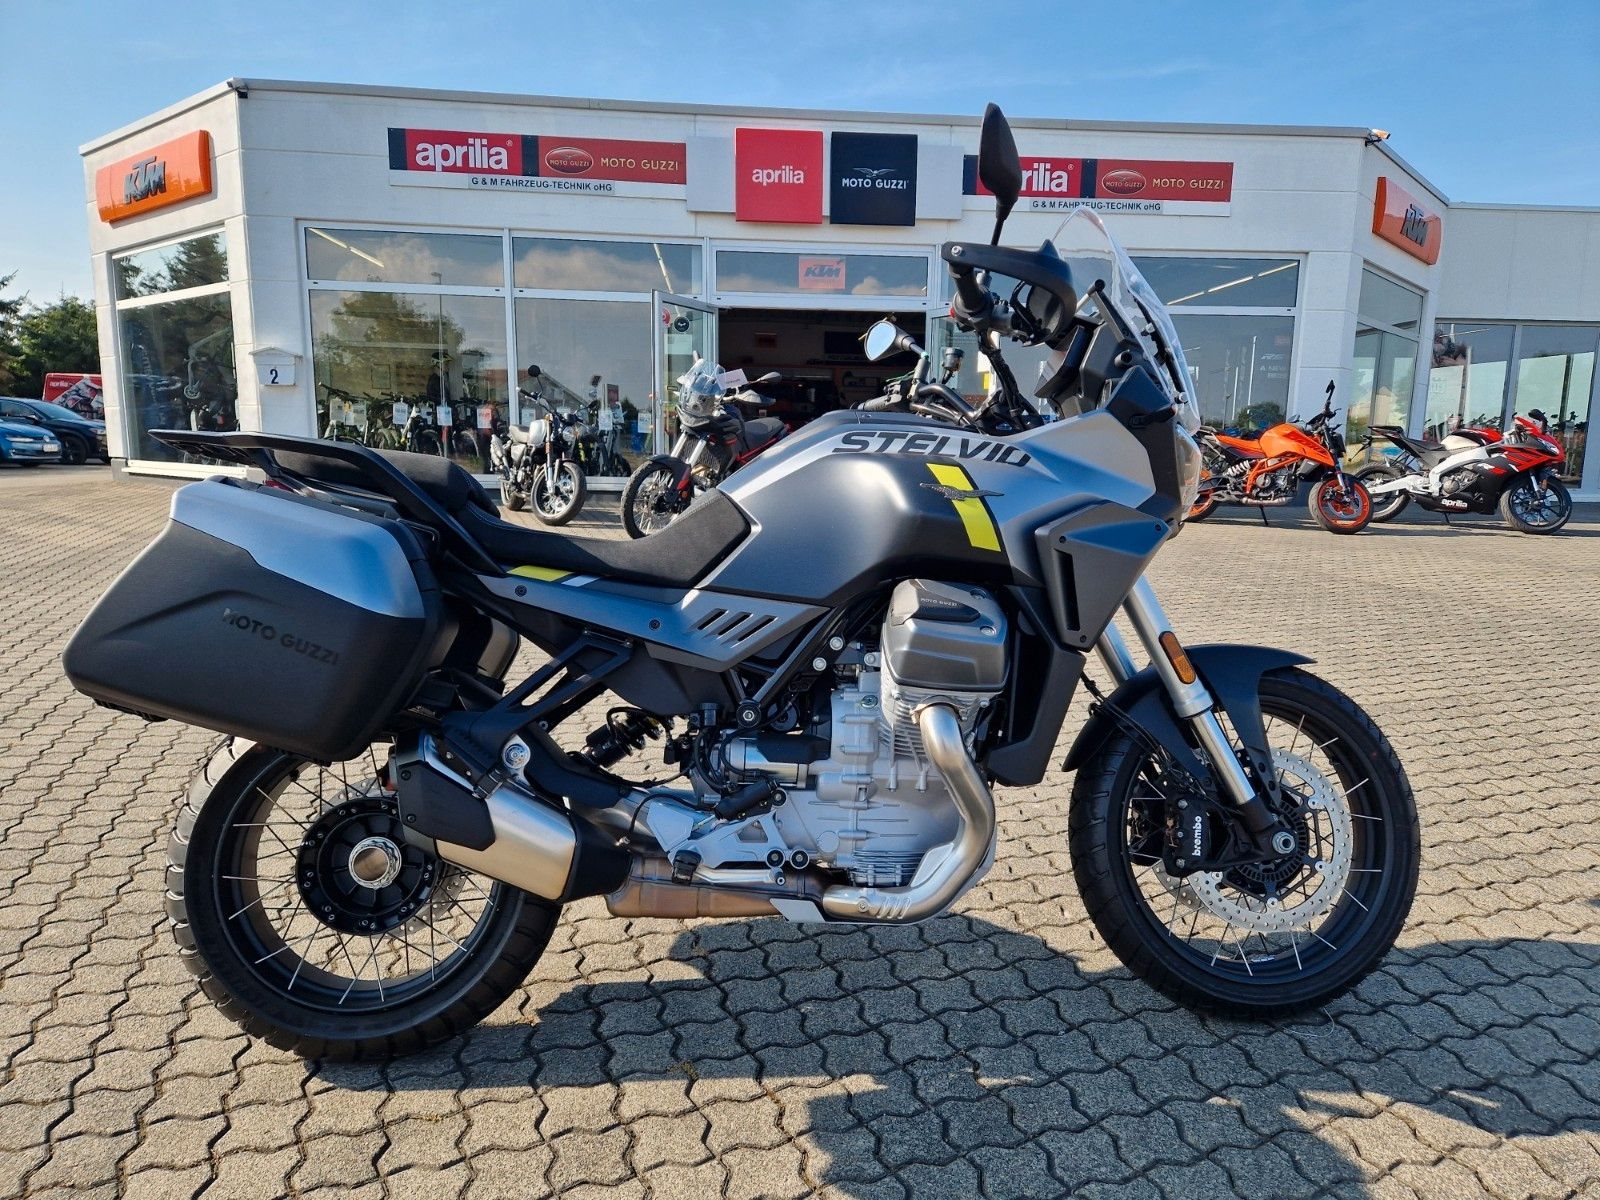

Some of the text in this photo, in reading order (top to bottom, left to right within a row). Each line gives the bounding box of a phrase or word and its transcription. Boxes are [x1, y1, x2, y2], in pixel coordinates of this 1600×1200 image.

[415, 137, 509, 172] aprilia
[600, 157, 679, 172] MOTO GUZZI
[123, 155, 166, 205] KTM
[471, 177, 613, 192] G & M FAHRZEUG-TECHNIK oHG
[751, 165, 805, 187] aprilia
[841, 177, 907, 190] MOTO GUZZI
[1020, 162, 1069, 193] rilia
[1152, 178, 1225, 190] MOTO GUZZI
[1032, 200, 1039, 208] G
[1143, 202, 1161, 211] oHG
[1400, 203, 1429, 247] KTM
[804, 264, 842, 278] KTM
[270, 368, 279, 385] 2
[831, 431, 1032, 467] STELVIO
[1441, 498, 1468, 508] aprilia
[222, 607, 339, 666] MOTO GUZZI
[1191, 815, 1203, 857] brembo
